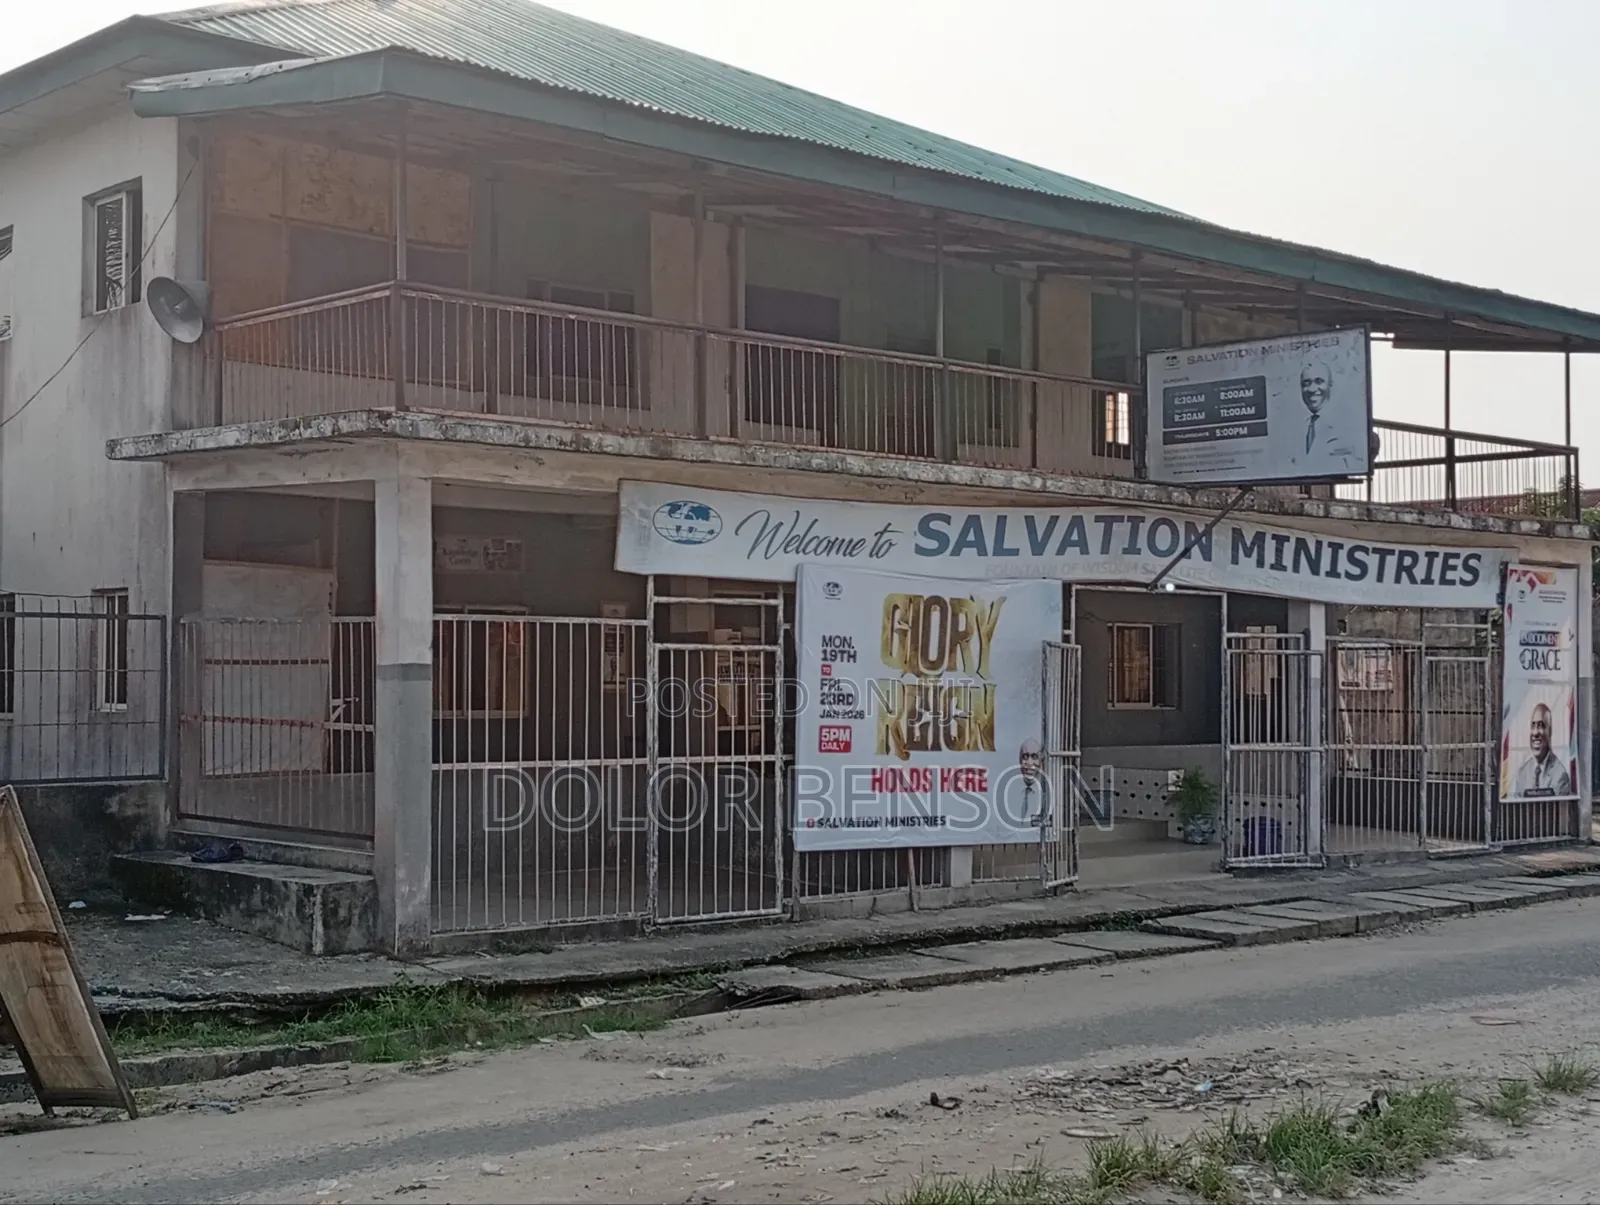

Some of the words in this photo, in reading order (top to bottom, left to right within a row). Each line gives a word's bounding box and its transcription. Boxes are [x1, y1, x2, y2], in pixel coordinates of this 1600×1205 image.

[1187, 349, 1258, 365] SALVATION
[1261, 336, 1340, 355] MINISTRIES
[1220, 389, 1254, 400] 8:00AM
[1220, 406, 1256, 418] 11:00AM
[1215, 427, 1248, 437] 5:00PM
[734, 509, 866, 560] Welcome
[868, 522, 903, 559] to
[914, 512, 1213, 563] SALVATION
[1230, 527, 1482, 588] MINISTRIES
[1061, 562, 1081, 575] OF
[821, 634, 855, 650] MON.
[879, 592, 1007, 681] GLORY
[821, 649, 857, 663] 19TH
[1522, 648, 1561, 671] GRACE
[820, 692, 855, 706] 23RD
[820, 709, 839, 719] JAN
[875, 677, 998, 761] REIGN
[821, 727, 851, 742] 5PM
[821, 741, 846, 751] DAILY
[871, 767, 932, 793] HOLDS
[940, 767, 988, 793] HERE
[816, 815, 881, 829] SALVATION
[884, 815, 946, 828] MINISTRIES
